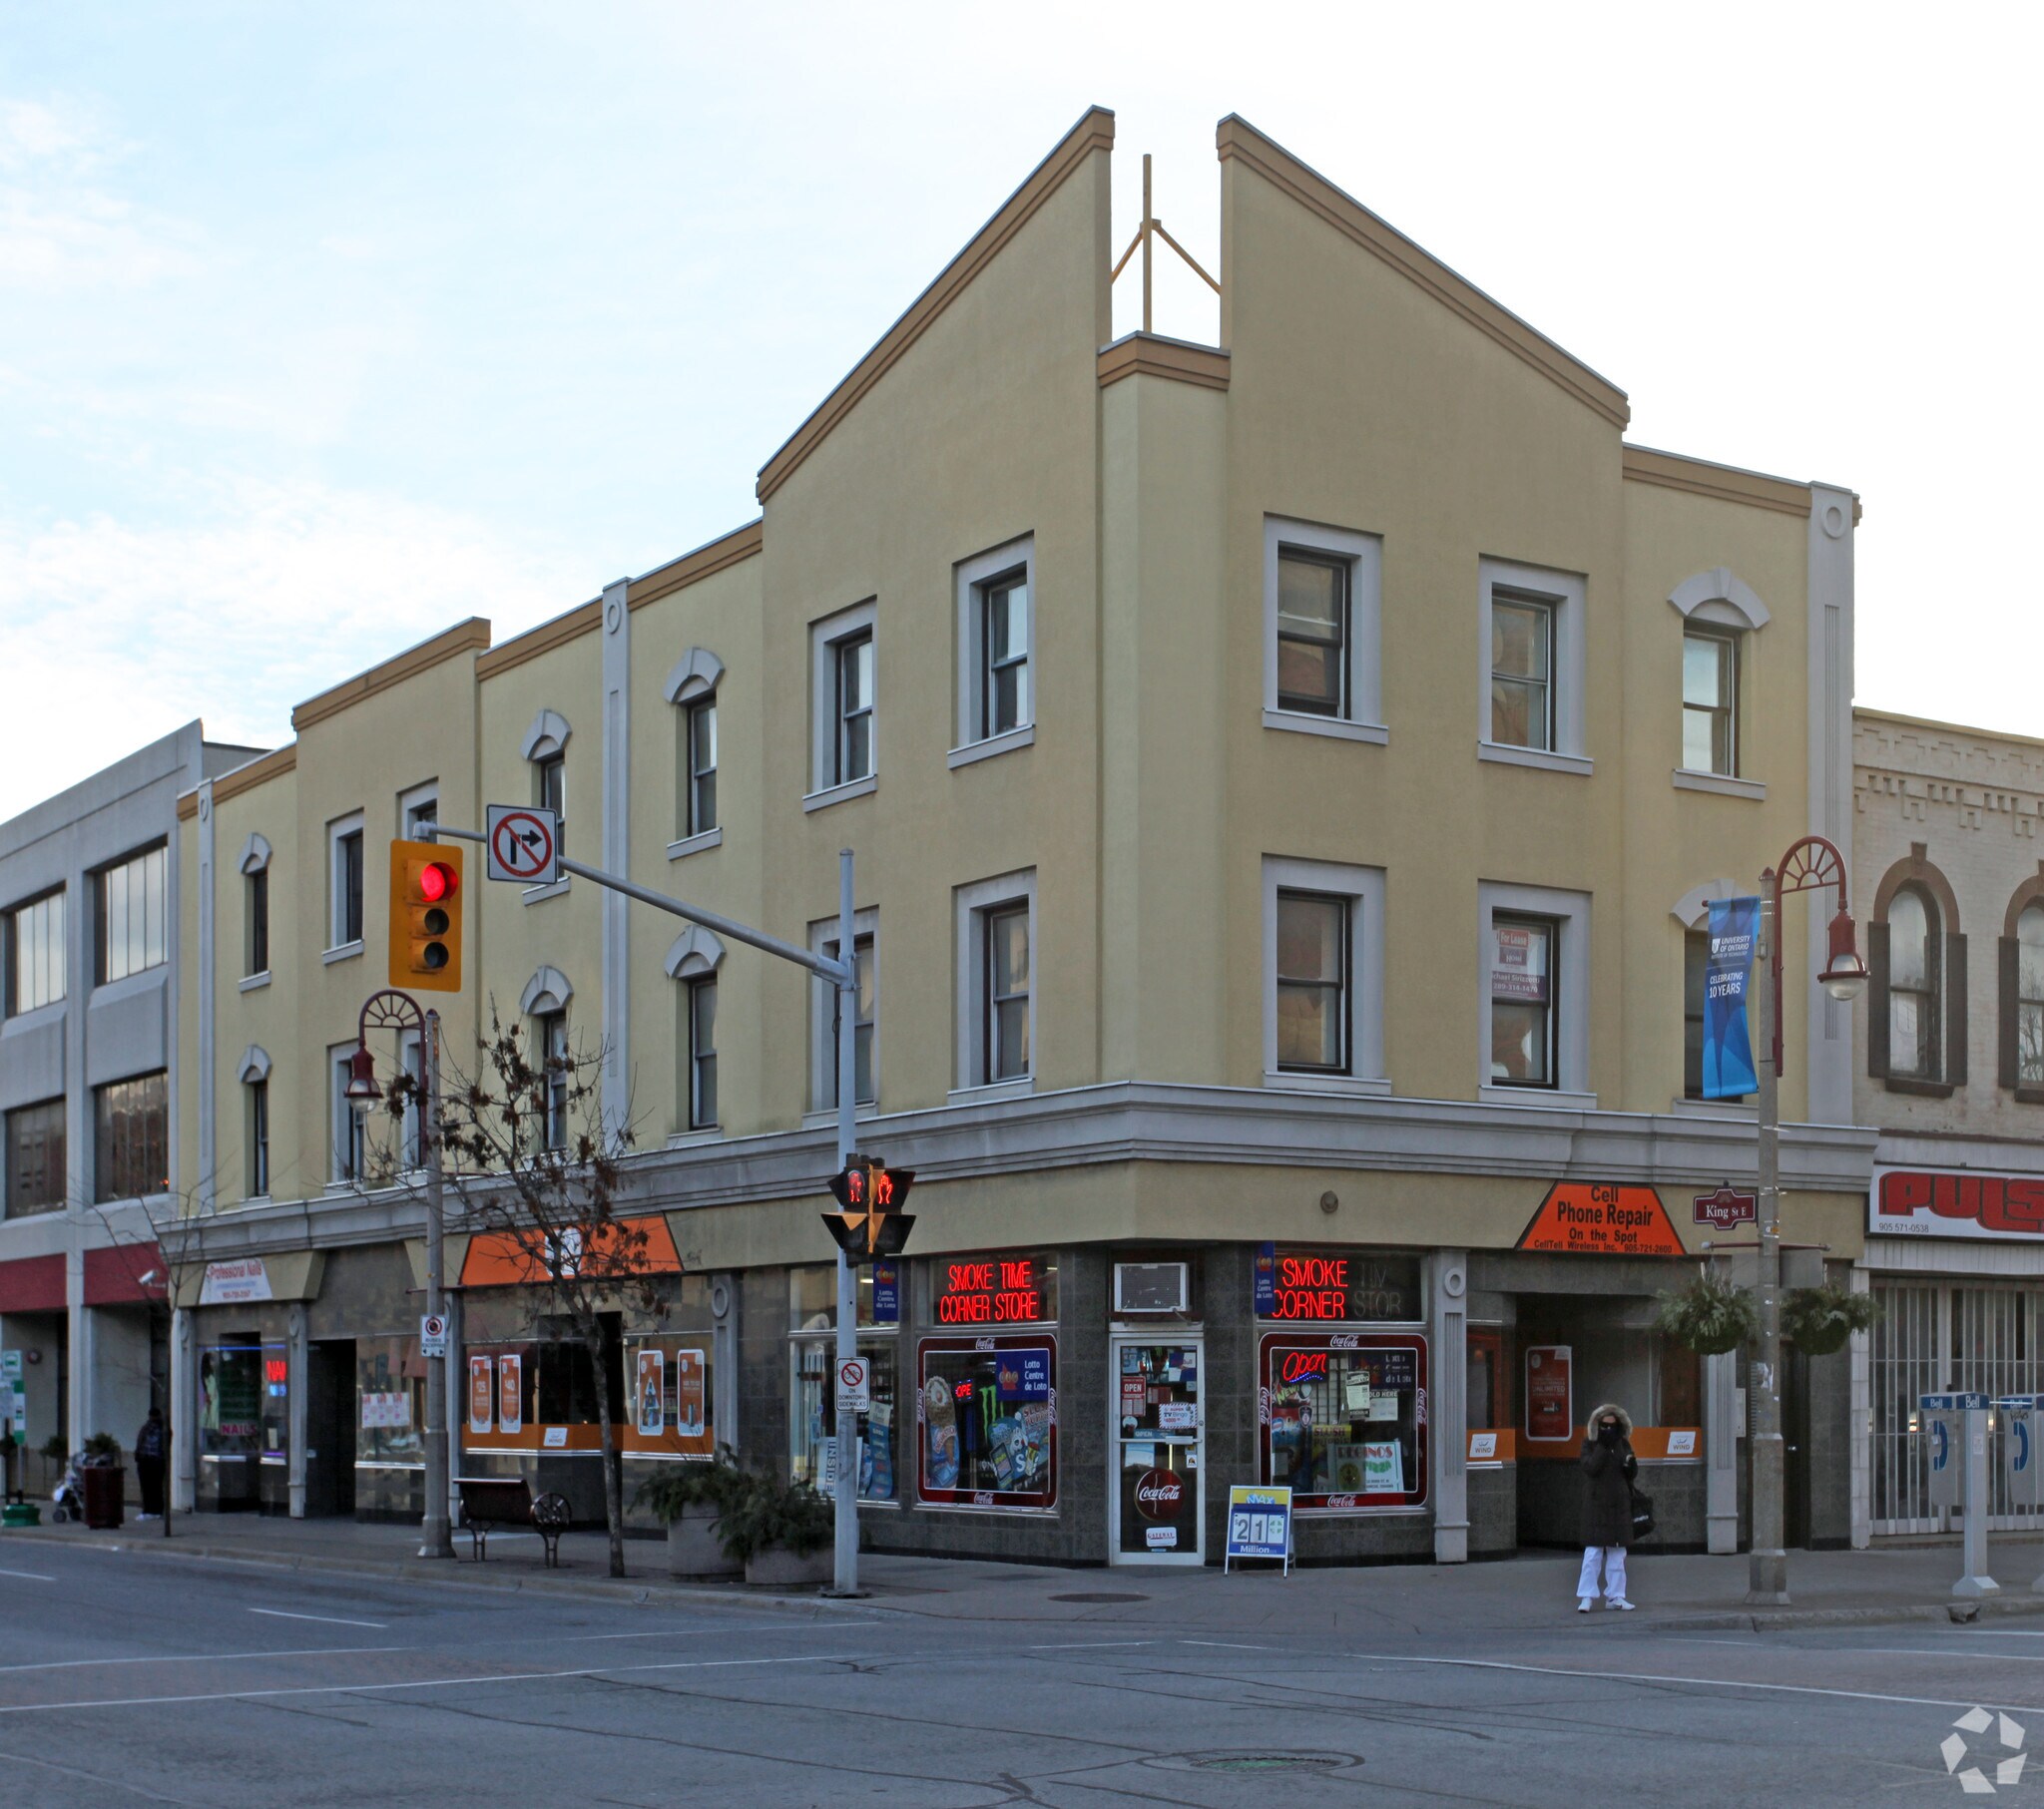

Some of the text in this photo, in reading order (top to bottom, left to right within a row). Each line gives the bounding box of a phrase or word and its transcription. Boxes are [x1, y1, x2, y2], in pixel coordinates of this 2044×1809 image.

[1500, 932, 1527, 946] For Lease
[1721, 935, 1752, 945] UNIVERSITY
[1728, 943, 1750, 952] ONTARIO
[1710, 972, 1744, 985] CELEBRATING
[1709, 982, 1742, 998] 10 YEARS
[1591, 1185, 1619, 1202] Cell
[1557, 1201, 1654, 1230] Phone Repair
[1706, 1204, 1747, 1219] King St E
[1895, 1224, 1929, 1233] 571-0538
[1569, 1227, 1638, 1245] On the Spot
[1534, 1239, 1563, 1248] CellTell
[1567, 1241, 1599, 1250] Wireless
[1603, 1242, 1618, 1251] Inc.
[207, 1260, 261, 1279] Professional Nails
[948, 1261, 1031, 1292] SMOKE TIME
[1281, 1257, 1348, 1288] SMOKE
[940, 1292, 1038, 1322] CORNER STORE
[1273, 1289, 1345, 1318] CORNER
[1025, 1360, 1040, 1369] Lotto
[1282, 1351, 1326, 1381] Open
[1024, 1371, 1044, 1380] Centre
[1024, 1382, 1047, 1391] de Loto
[1124, 1383, 1142, 1392] OPEN
[1930, 1398, 1943, 1408] Bell
[1965, 1395, 1980, 1409] Bell
[221, 1423, 256, 1435] NAILS
[825, 1441, 836, 1493] INSIDE
[1240, 1545, 1270, 1554] Million
